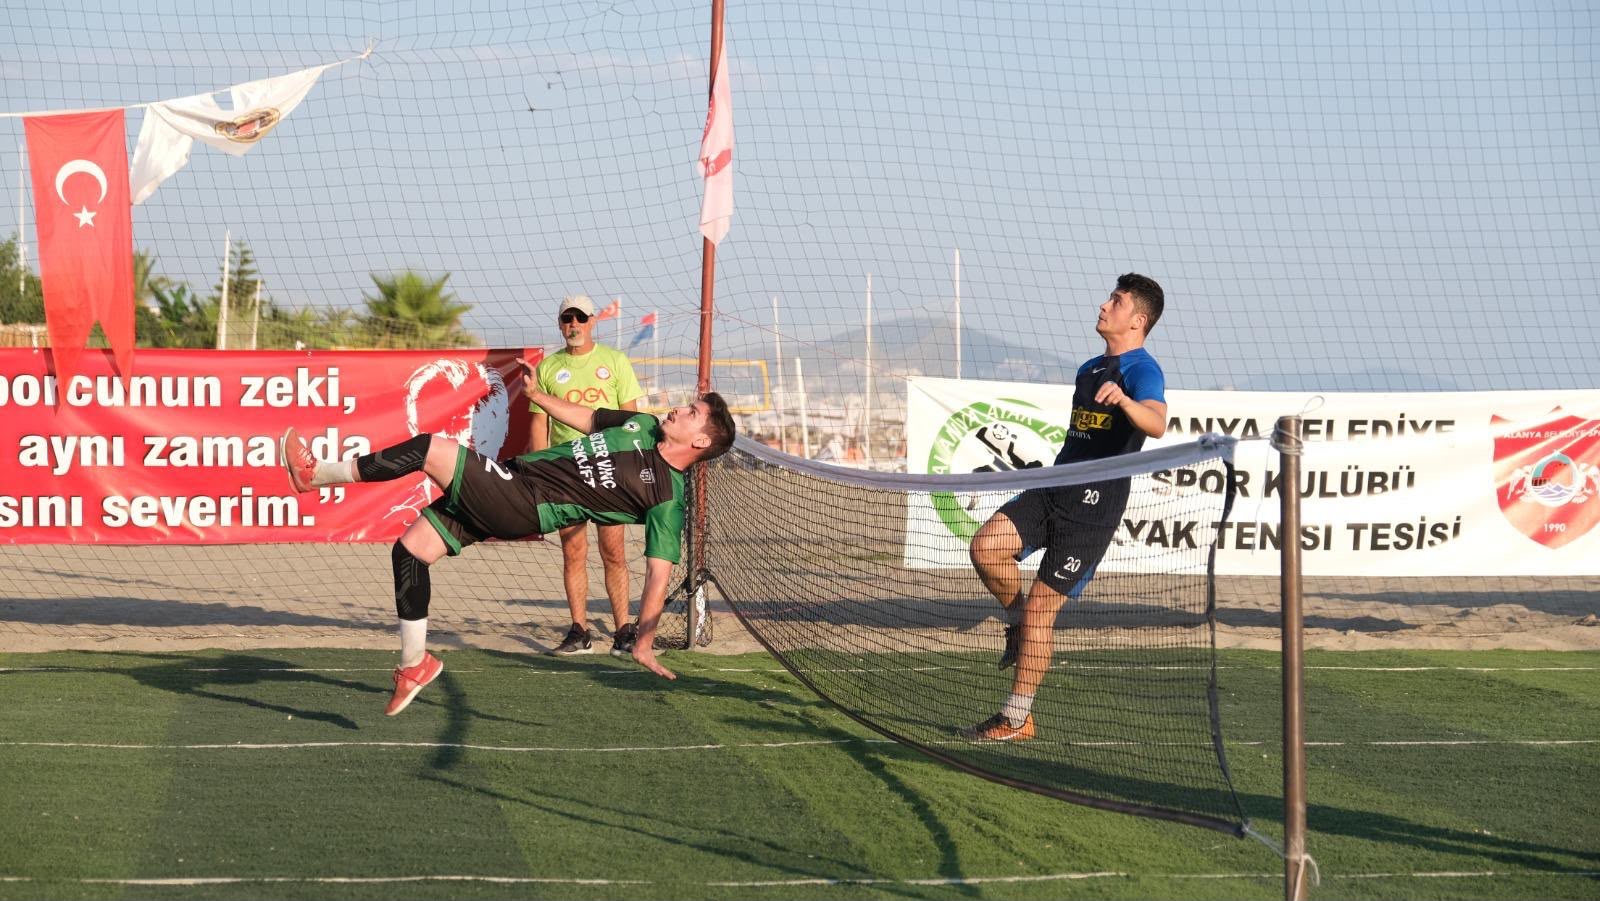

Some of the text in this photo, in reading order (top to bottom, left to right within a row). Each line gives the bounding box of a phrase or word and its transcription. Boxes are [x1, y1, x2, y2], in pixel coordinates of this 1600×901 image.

[239, 367, 357, 415] zeki,
[553, 387, 609, 404] OGA
[1166, 416, 1262, 440] ANYA
[18, 427, 371, 476] aynı zamada
[1082, 488, 1100, 505] 20
[1111, 518, 1199, 549] YAK
[1346, 515, 1462, 551] TESİSİ
[1543, 522, 1567, 533] 1990
[1063, 556, 1081, 573] 20
